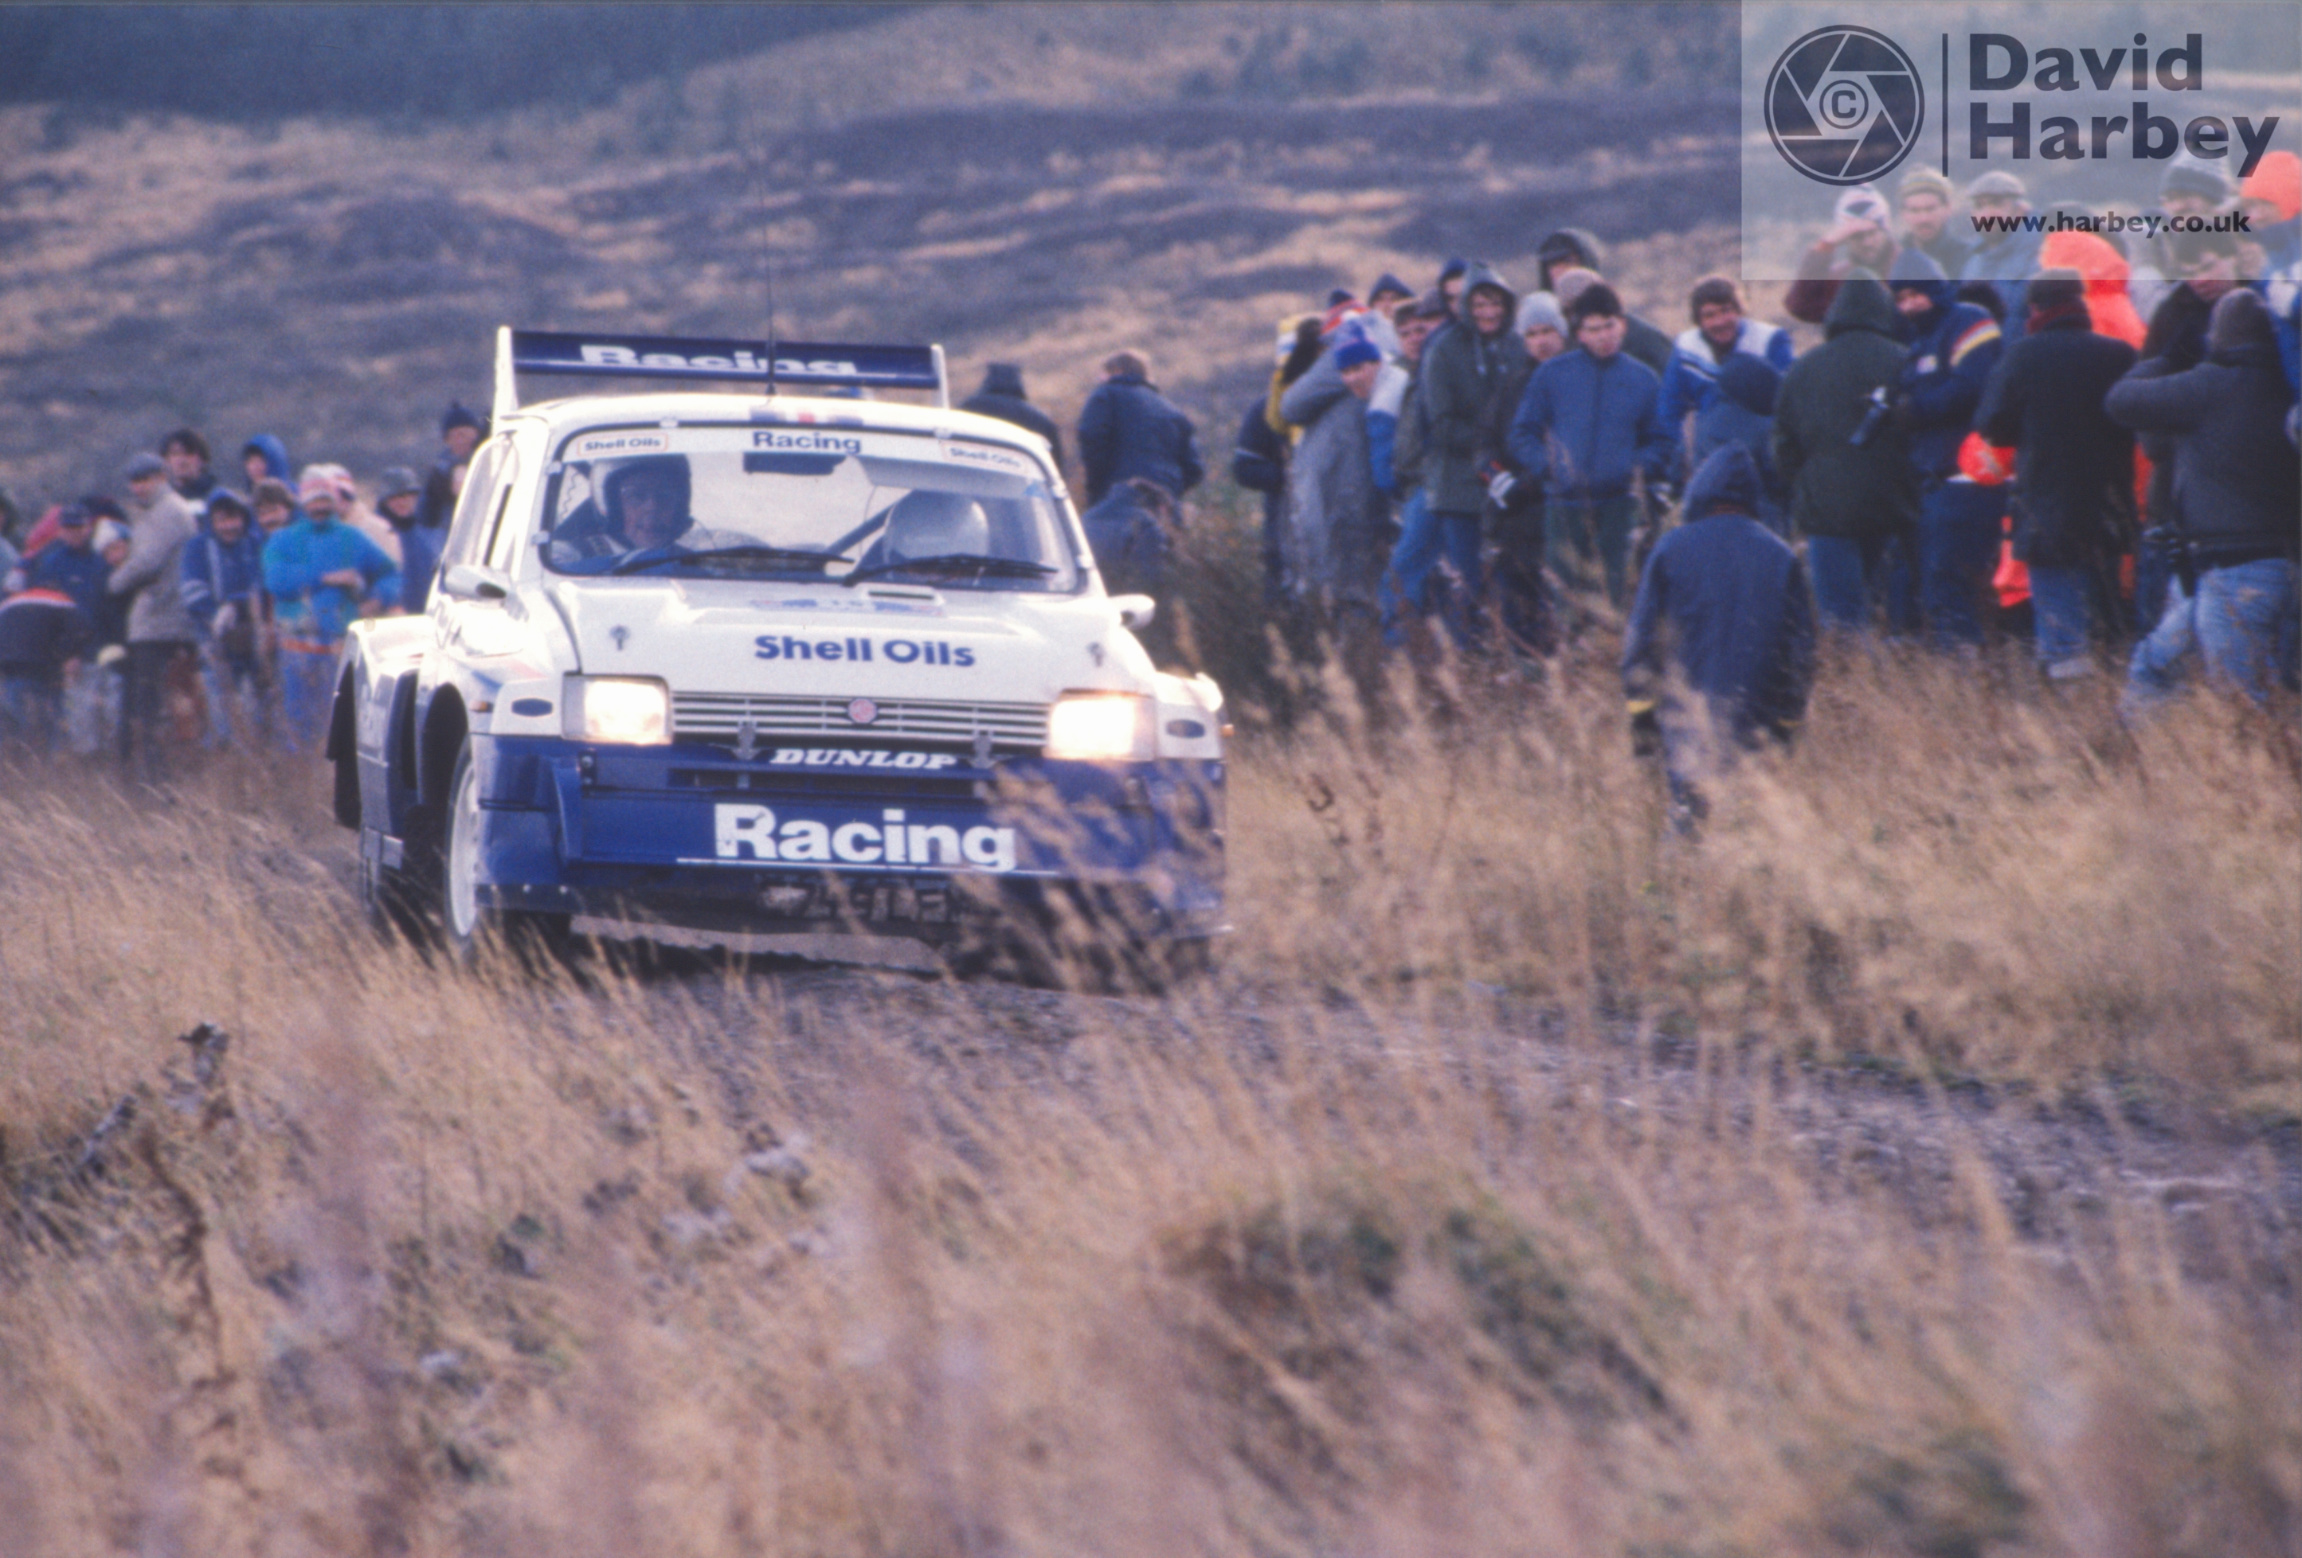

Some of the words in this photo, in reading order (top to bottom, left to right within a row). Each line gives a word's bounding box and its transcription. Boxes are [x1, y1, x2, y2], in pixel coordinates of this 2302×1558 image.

[584, 439, 625, 452] Shell
[628, 437, 661, 448] Oils
[752, 430, 861, 455] Racing
[755, 635, 873, 662] Shell
[883, 639, 976, 667] Oils
[769, 749, 957, 770] DUNLOP
[714, 803, 1017, 873] Racing
